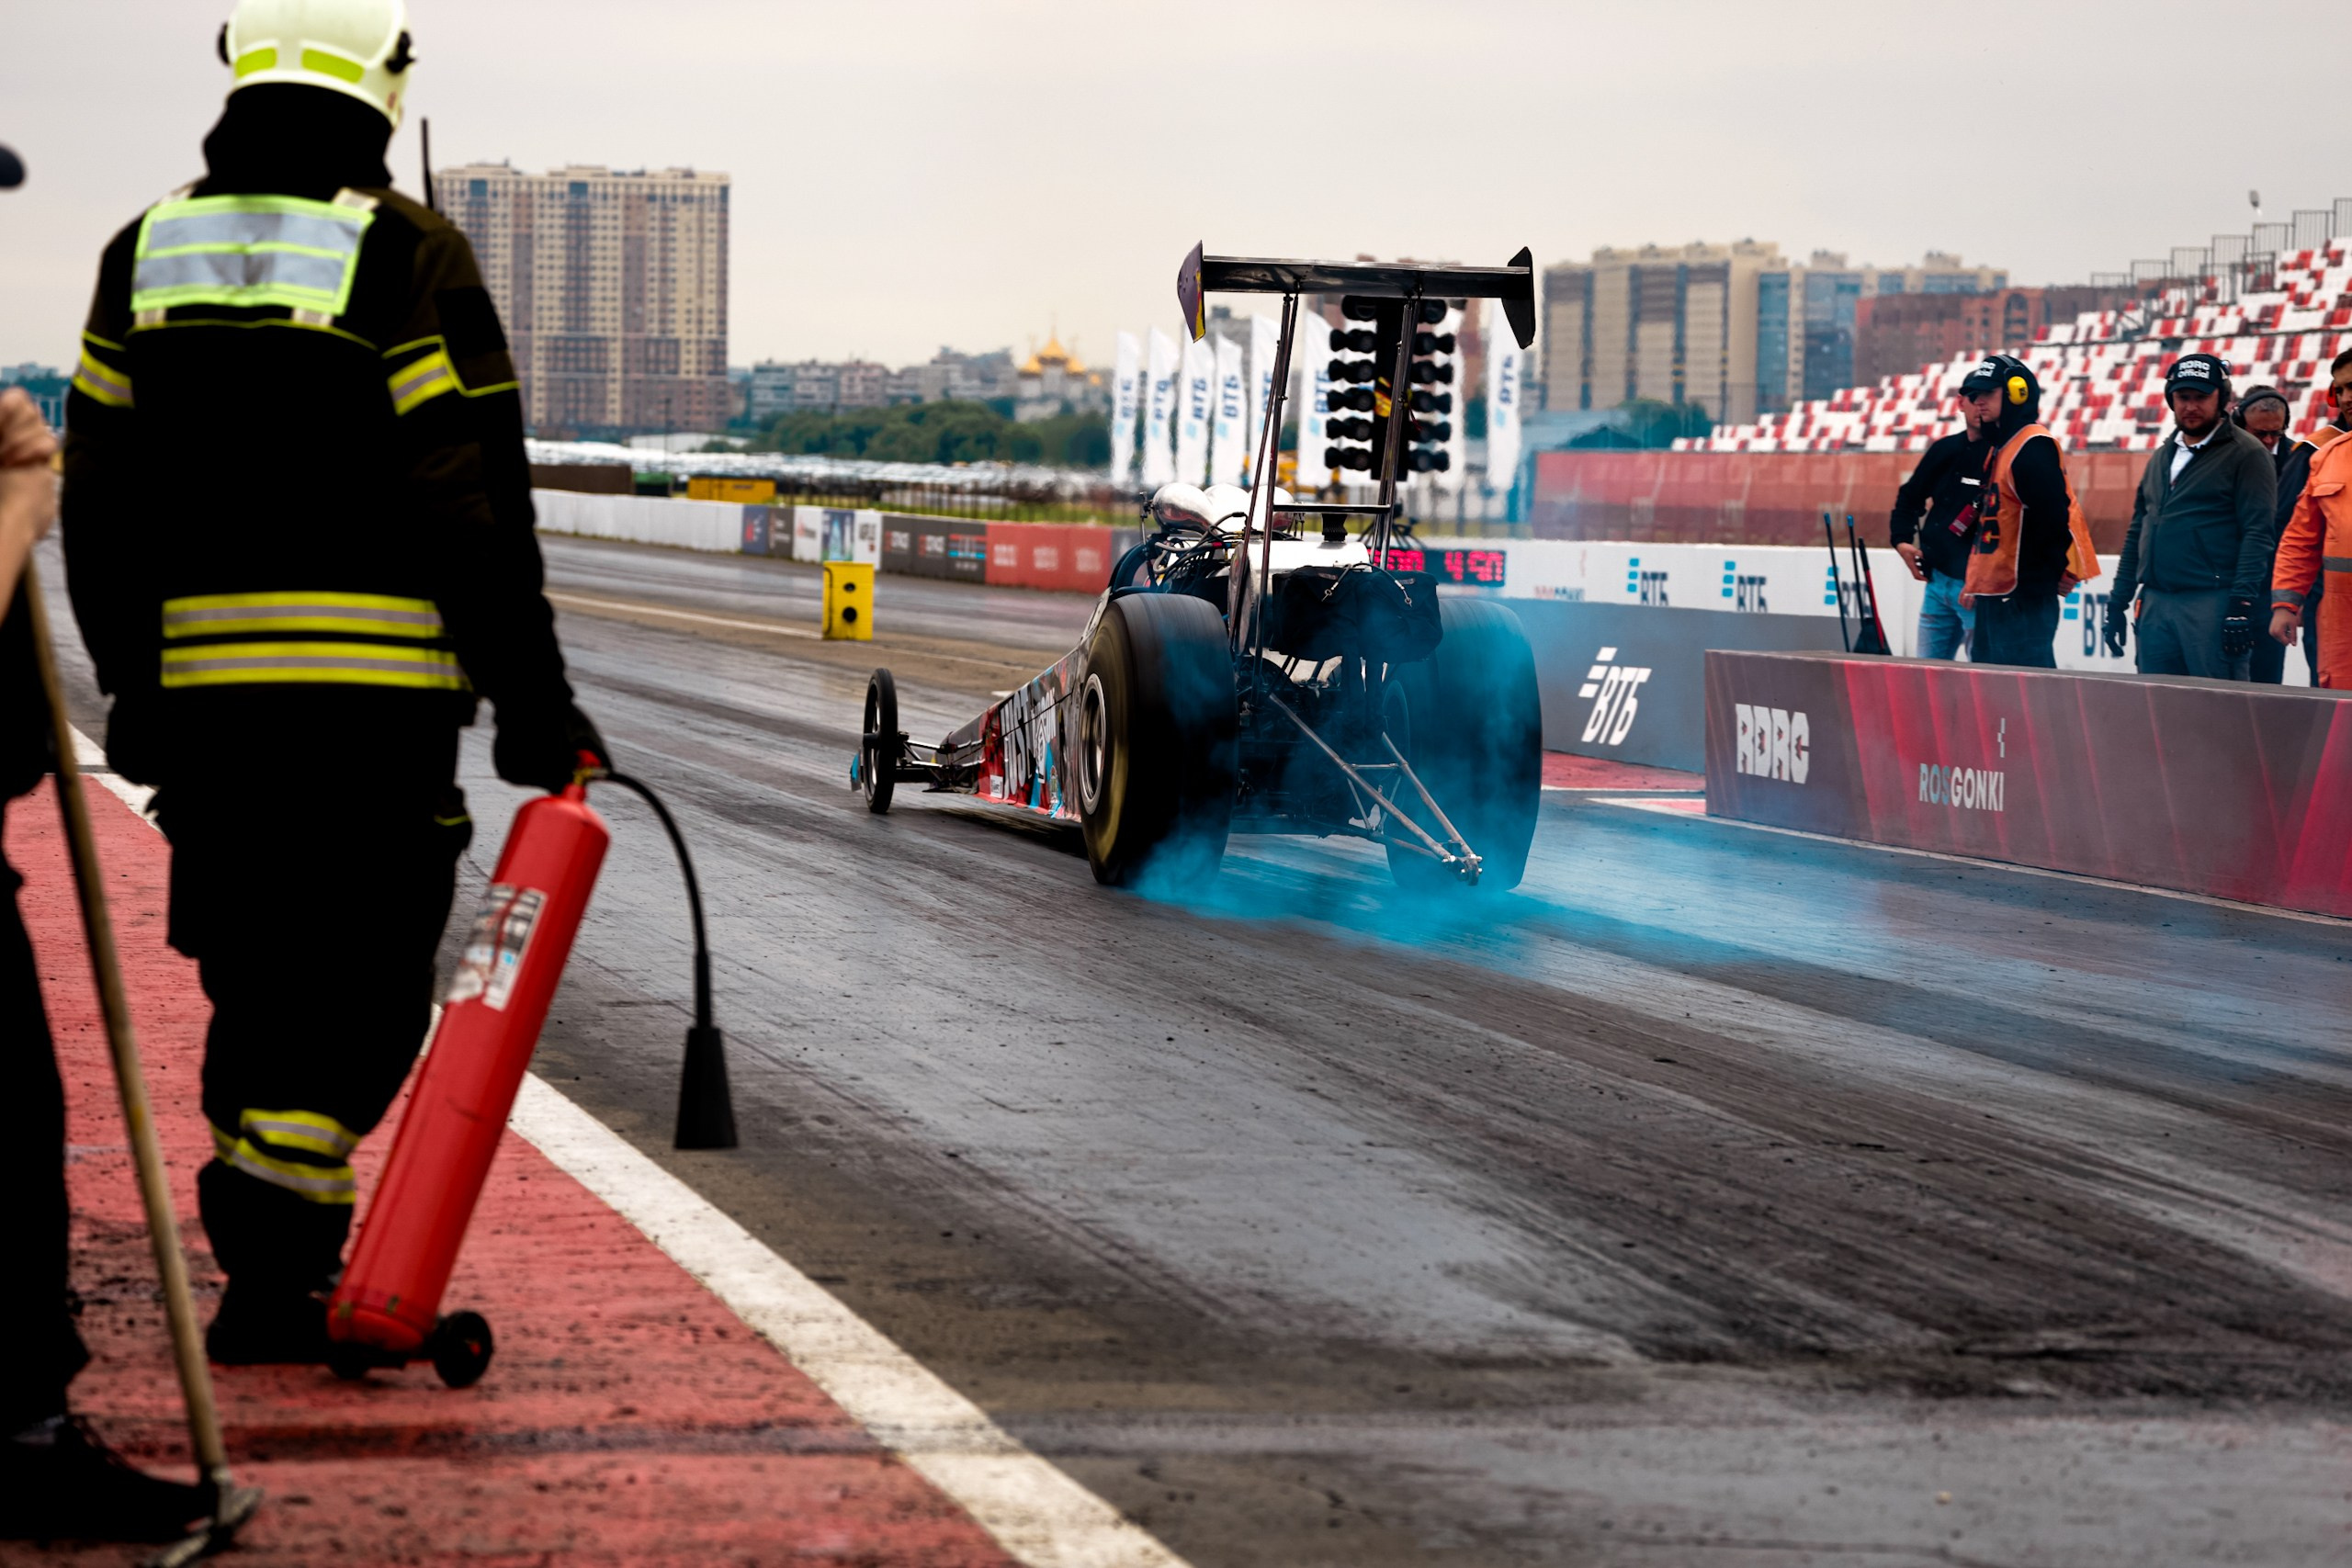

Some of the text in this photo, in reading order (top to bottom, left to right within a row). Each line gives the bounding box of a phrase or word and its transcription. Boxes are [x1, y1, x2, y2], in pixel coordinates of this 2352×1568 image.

[1581, 666, 1652, 746] ВТБ
[1735, 703, 1810, 784] RDRC
[1918, 762, 2005, 812] ROSGONKI
